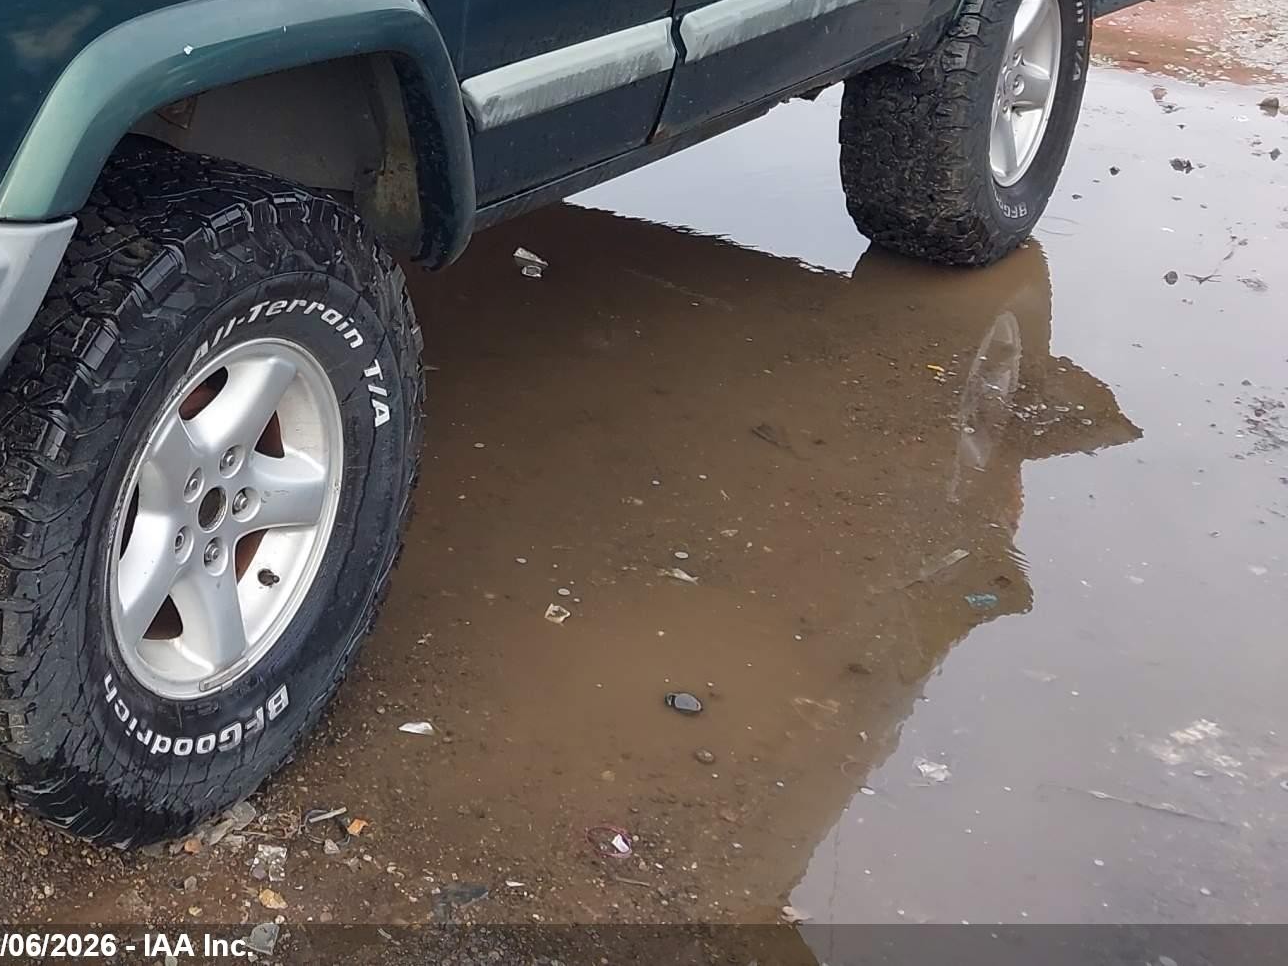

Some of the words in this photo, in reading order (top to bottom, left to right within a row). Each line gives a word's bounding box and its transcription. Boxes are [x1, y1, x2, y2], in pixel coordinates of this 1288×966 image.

[185, 298, 365, 378] All-Terrain
[363, 358, 391, 428] T/A
[103, 672, 290, 757] BFGoodrich
